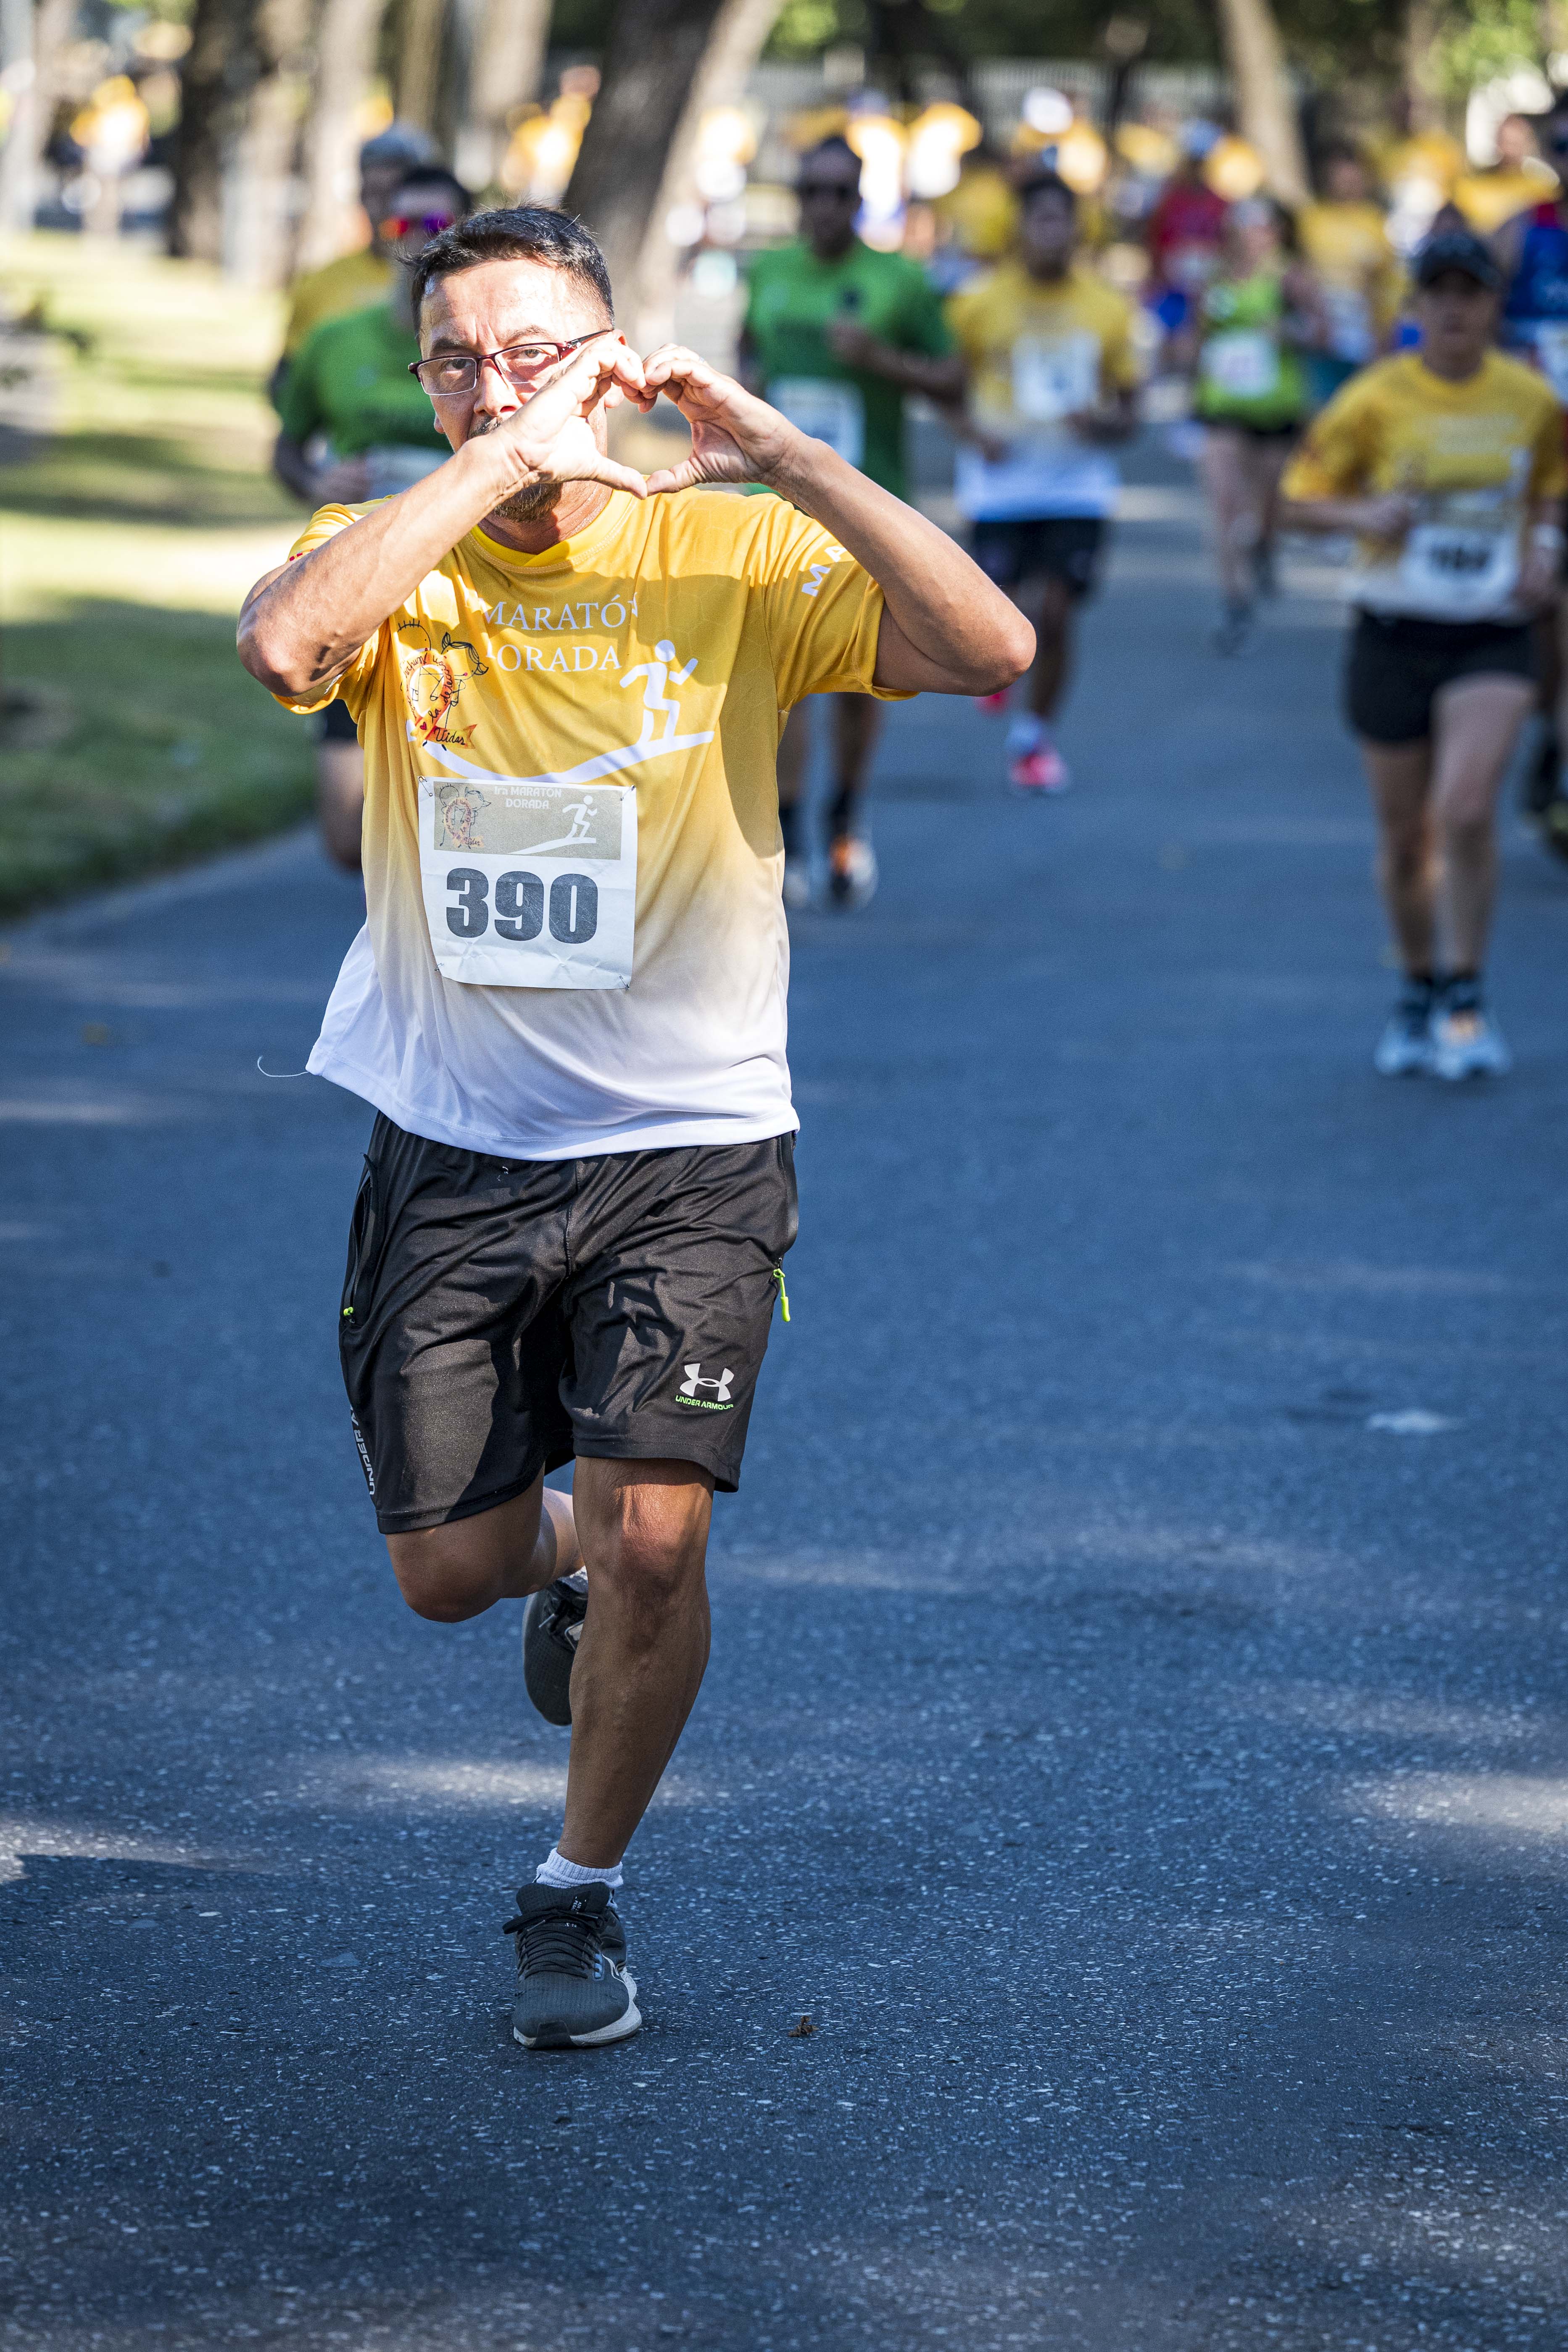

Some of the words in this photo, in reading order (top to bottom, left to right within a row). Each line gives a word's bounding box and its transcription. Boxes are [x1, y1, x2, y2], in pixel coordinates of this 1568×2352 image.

[506, 798, 549, 809] DORADA
[446, 868, 598, 944] 390
[675, 1395, 700, 1406] UNDER
[701, 1401, 734, 1410] ARMOUR
[354, 1430, 375, 1495] UNDER
